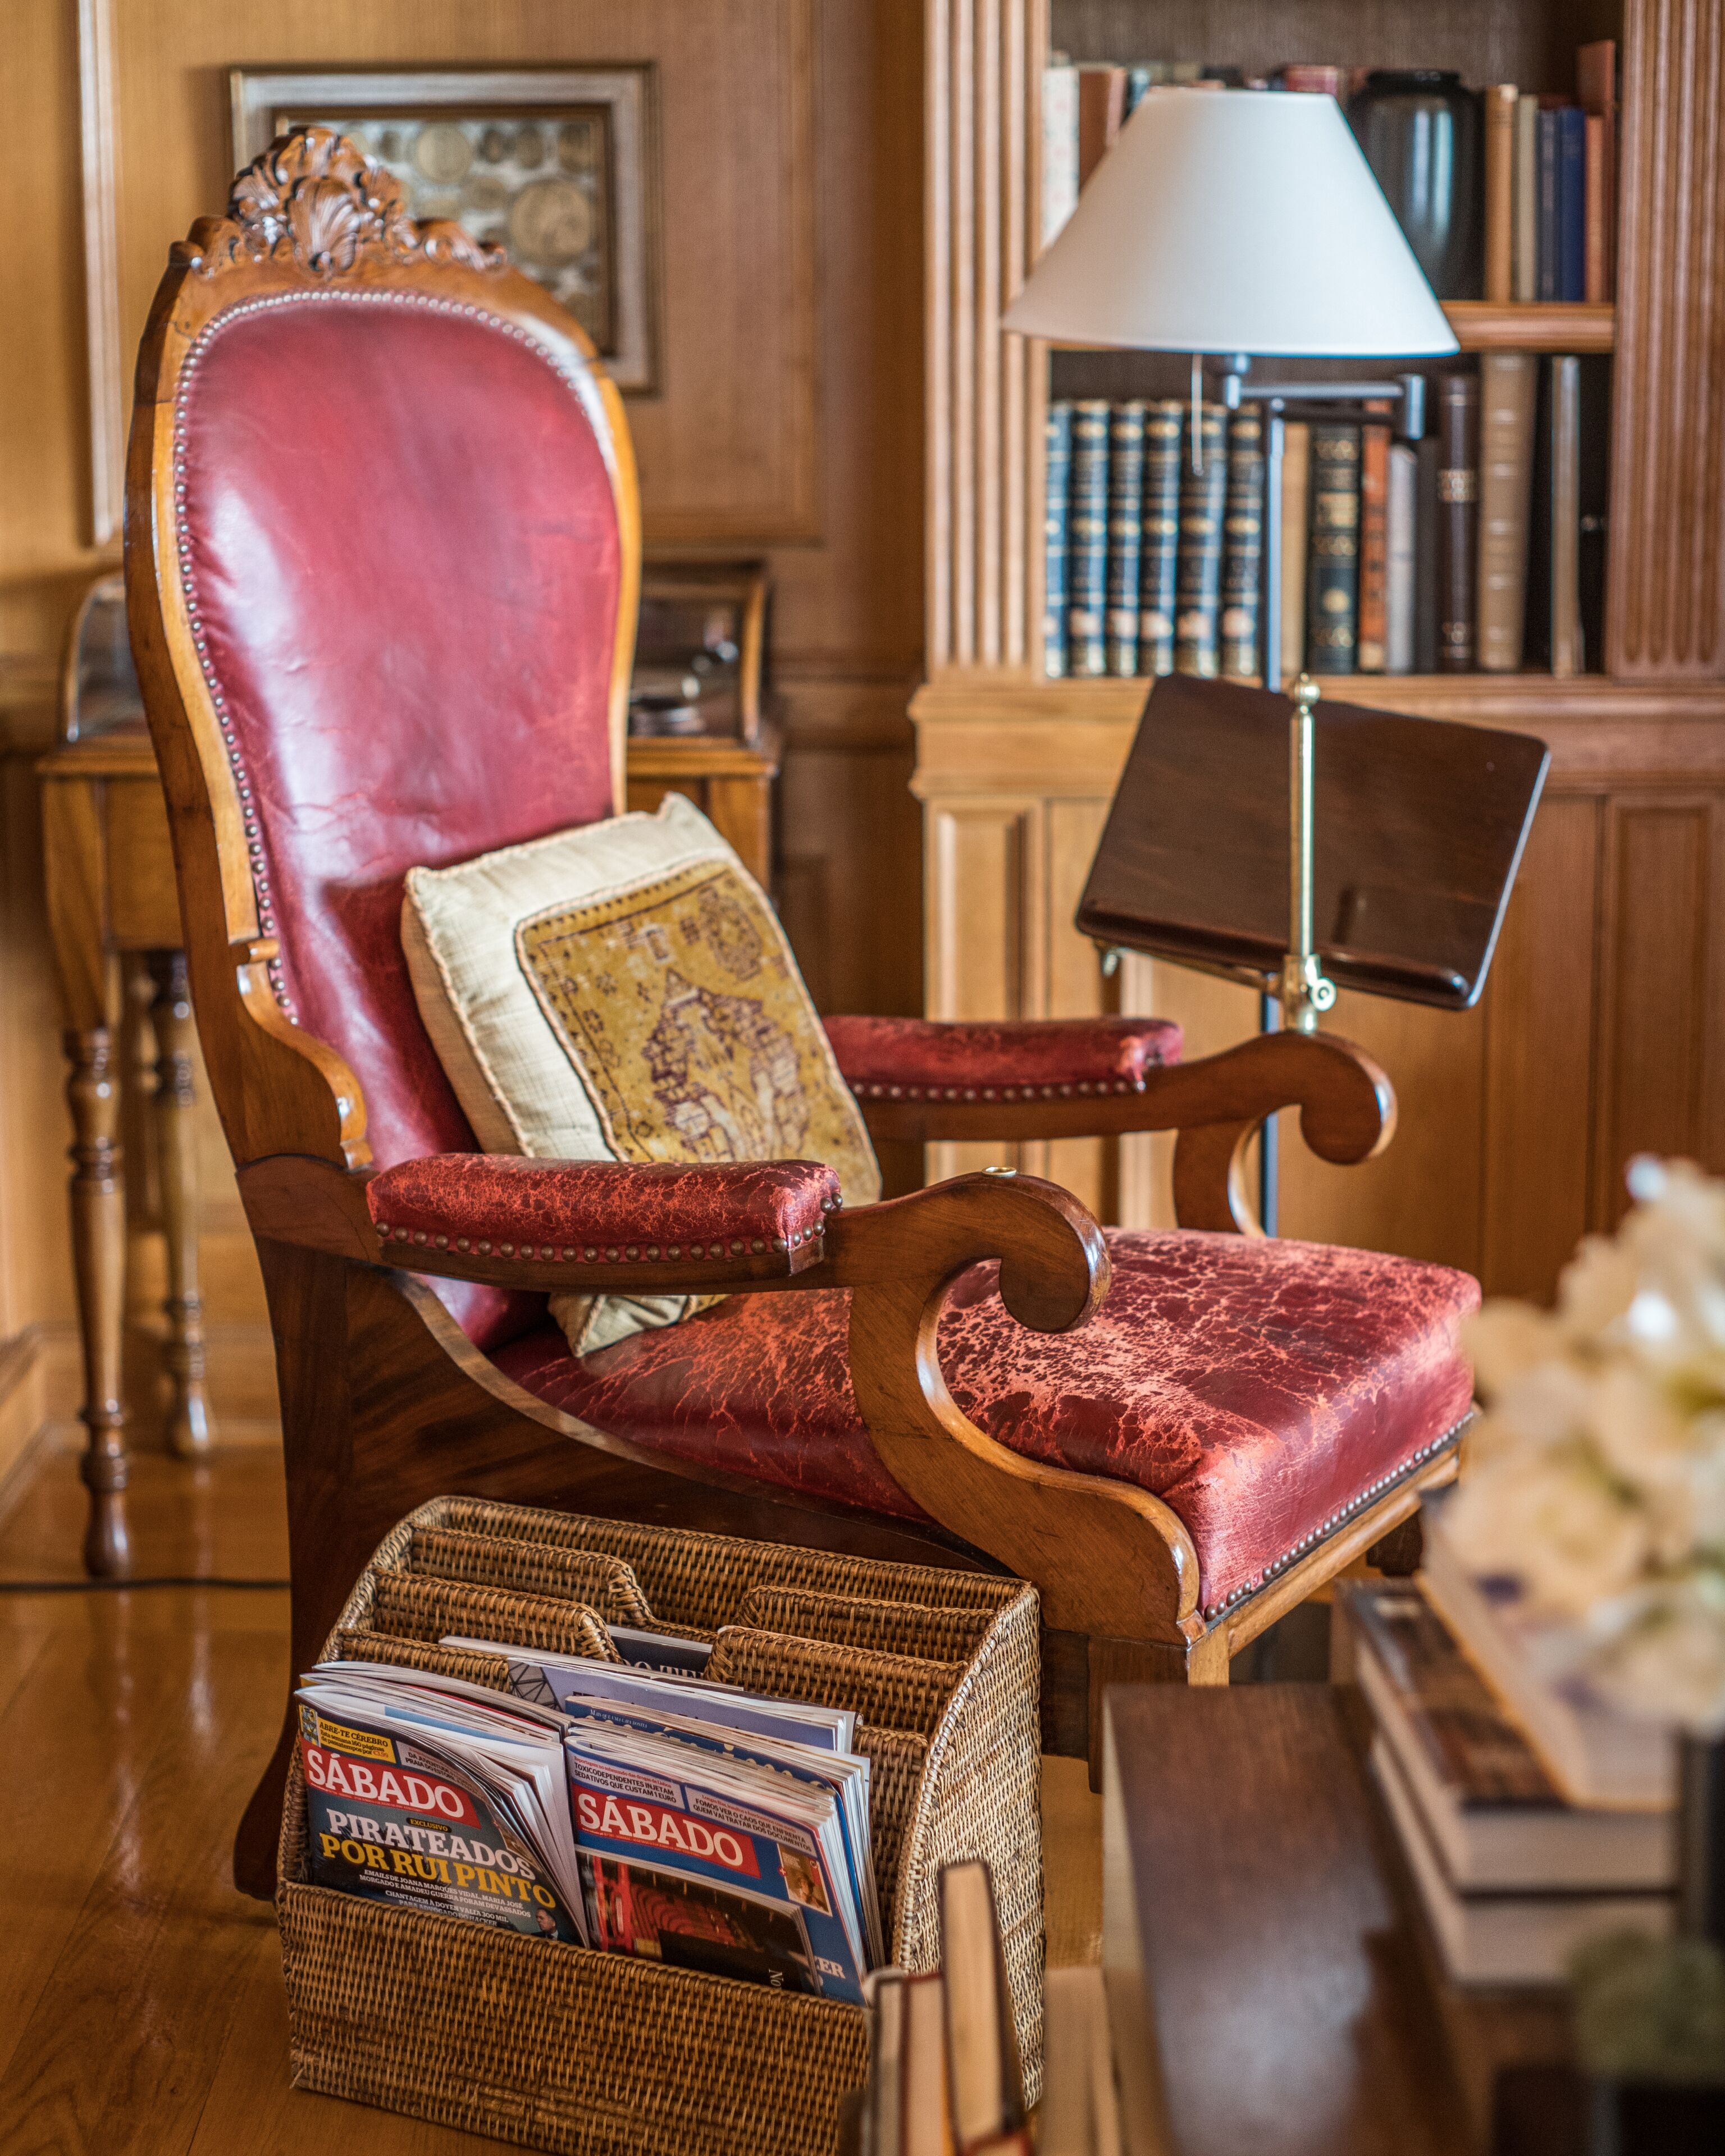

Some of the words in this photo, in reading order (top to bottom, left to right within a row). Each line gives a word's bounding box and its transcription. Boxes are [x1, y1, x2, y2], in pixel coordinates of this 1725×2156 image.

[320, 1722, 349, 1738] ABRE-TE
[351, 1733, 388, 1747] CÉREBRO
[405, 1757, 424, 1767] PRAIA
[307, 1749, 464, 1818] SÁBADO
[574, 1762, 644, 1787] TOXICODEPENDENTES
[645, 1783, 673, 1796] INJETAM
[574, 1770, 608, 1785] SEDATIVOS
[610, 1781, 623, 1789] QUE
[625, 1784, 653, 1797] CUSTAM
[659, 1793, 677, 1803] EURO
[410, 1819, 448, 1831] EXCLUSIVO
[578, 1793, 743, 1866] SÁBADO
[693, 1804, 713, 1816] QUEM
[713, 1810, 725, 1820] VAI
[725, 1815, 752, 1829] TRATAR
[752, 1824, 767, 1834] DOS
[696, 1798, 719, 1811] FOMOS
[719, 1806, 733, 1816] VER
[739, 1814, 757, 1825] CAOS
[758, 1820, 771, 1829] QUE
[326, 1808, 536, 1880] PIRATEADOS
[320, 1833, 390, 1871] POR
[393, 1851, 451, 1884] RUI
[453, 1861, 556, 1908] PINTO
[364, 1869, 389, 1880] EMAILS
[400, 1877, 423, 1888] JOANA
[423, 1883, 458, 1894] MARQUES
[482, 1895, 505, 1905] MARIA
[359, 1875, 394, 1887] MORGADO
[400, 1884, 430, 1895] AMADEU
[431, 1890, 459, 1901] GUERRA
[459, 1897, 486, 1907] FORAM
[486, 1903, 531, 1918] DEVASSADOS
[385, 1890, 428, 1904] CHANTAGEM
[435, 1902, 459, 1912] DOYEN
[459, 1906, 481, 1917] VALIA
[469, 1915, 498, 1926] HACKER
